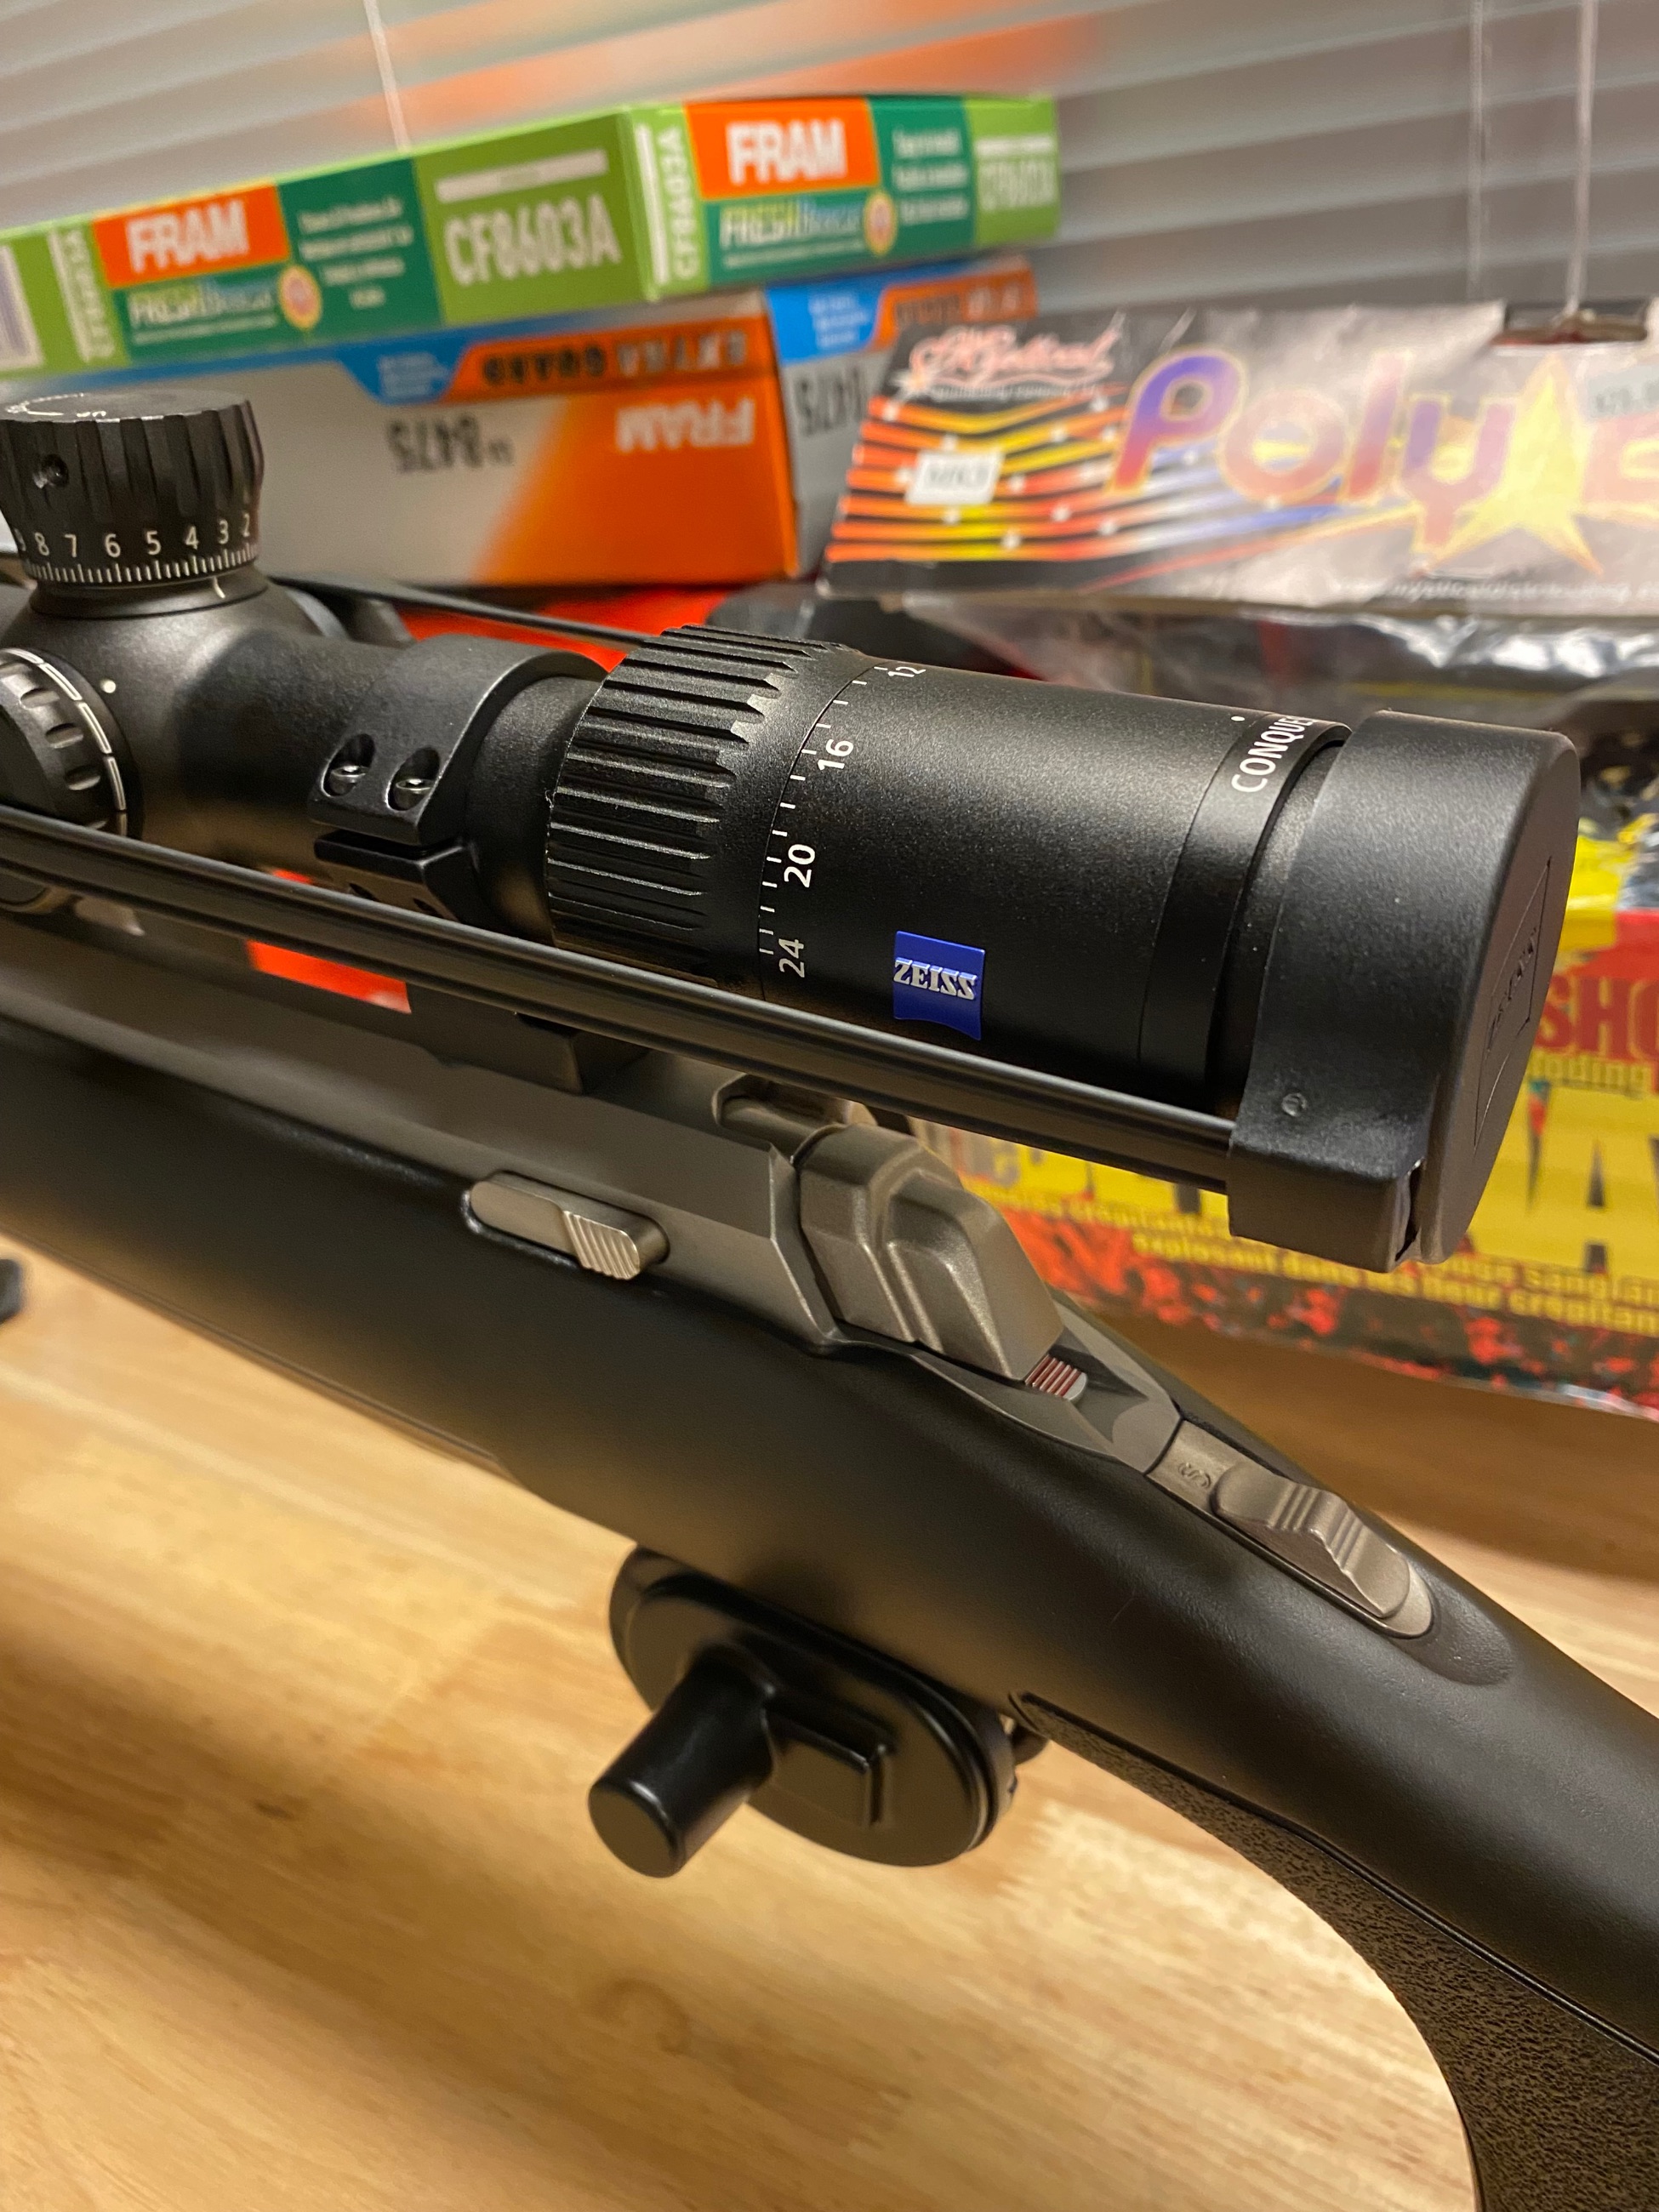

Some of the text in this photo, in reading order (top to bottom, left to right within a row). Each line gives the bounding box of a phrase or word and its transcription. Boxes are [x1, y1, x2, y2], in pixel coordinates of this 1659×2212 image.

[726, 117, 848, 185] FRAM
[125, 200, 250, 275] FRAM
[615, 396, 755, 453] FRAM
[1109, 348, 1519, 553] Poly
[34, 532, 49, 556] 8
[65, 533, 77, 558] 7
[105, 533, 122, 558] 6
[145, 530, 162, 556] 5
[185, 526, 199, 550] 4
[218, 519, 229, 544] 3
[242, 513, 250, 538] 2
[818, 738, 854, 771] 16
[1231, 715, 1315, 793] CONQUE
[784, 843, 816, 888] 20
[778, 938, 805, 978] 24
[893, 956, 978, 1001] ZEISS
